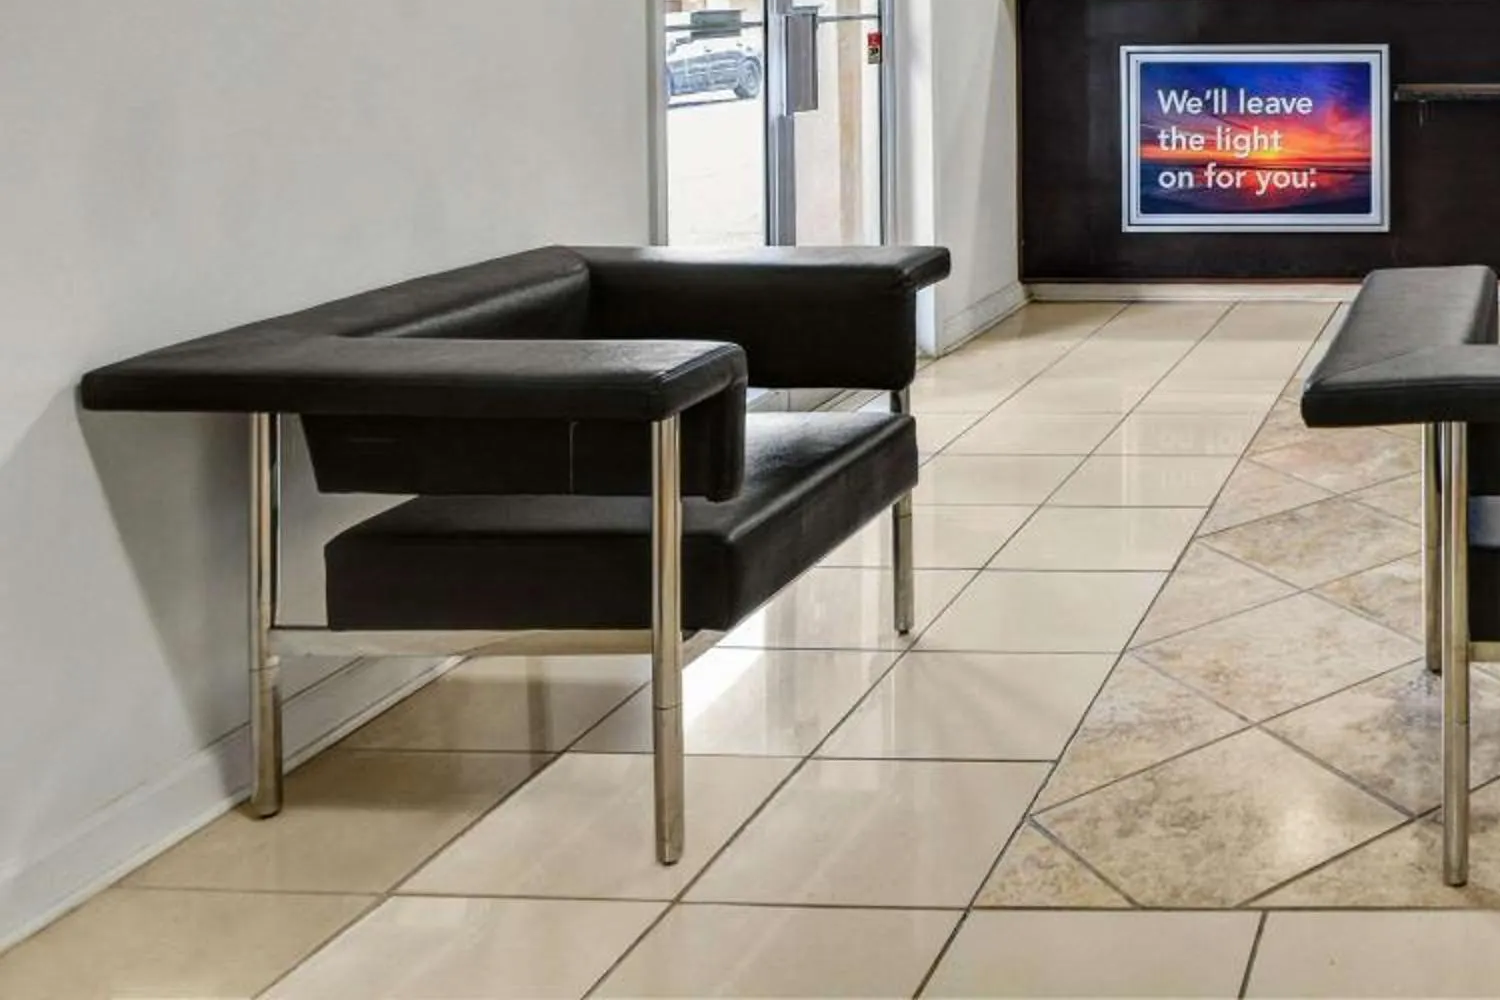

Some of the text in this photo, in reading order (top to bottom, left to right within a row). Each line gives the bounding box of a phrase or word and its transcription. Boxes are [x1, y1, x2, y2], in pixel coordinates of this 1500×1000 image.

[1157, 88, 1313, 115] We'll leave
[1157, 125, 1283, 158] the light
[1158, 170, 1194, 188] on
[1204, 163, 1248, 188] for
